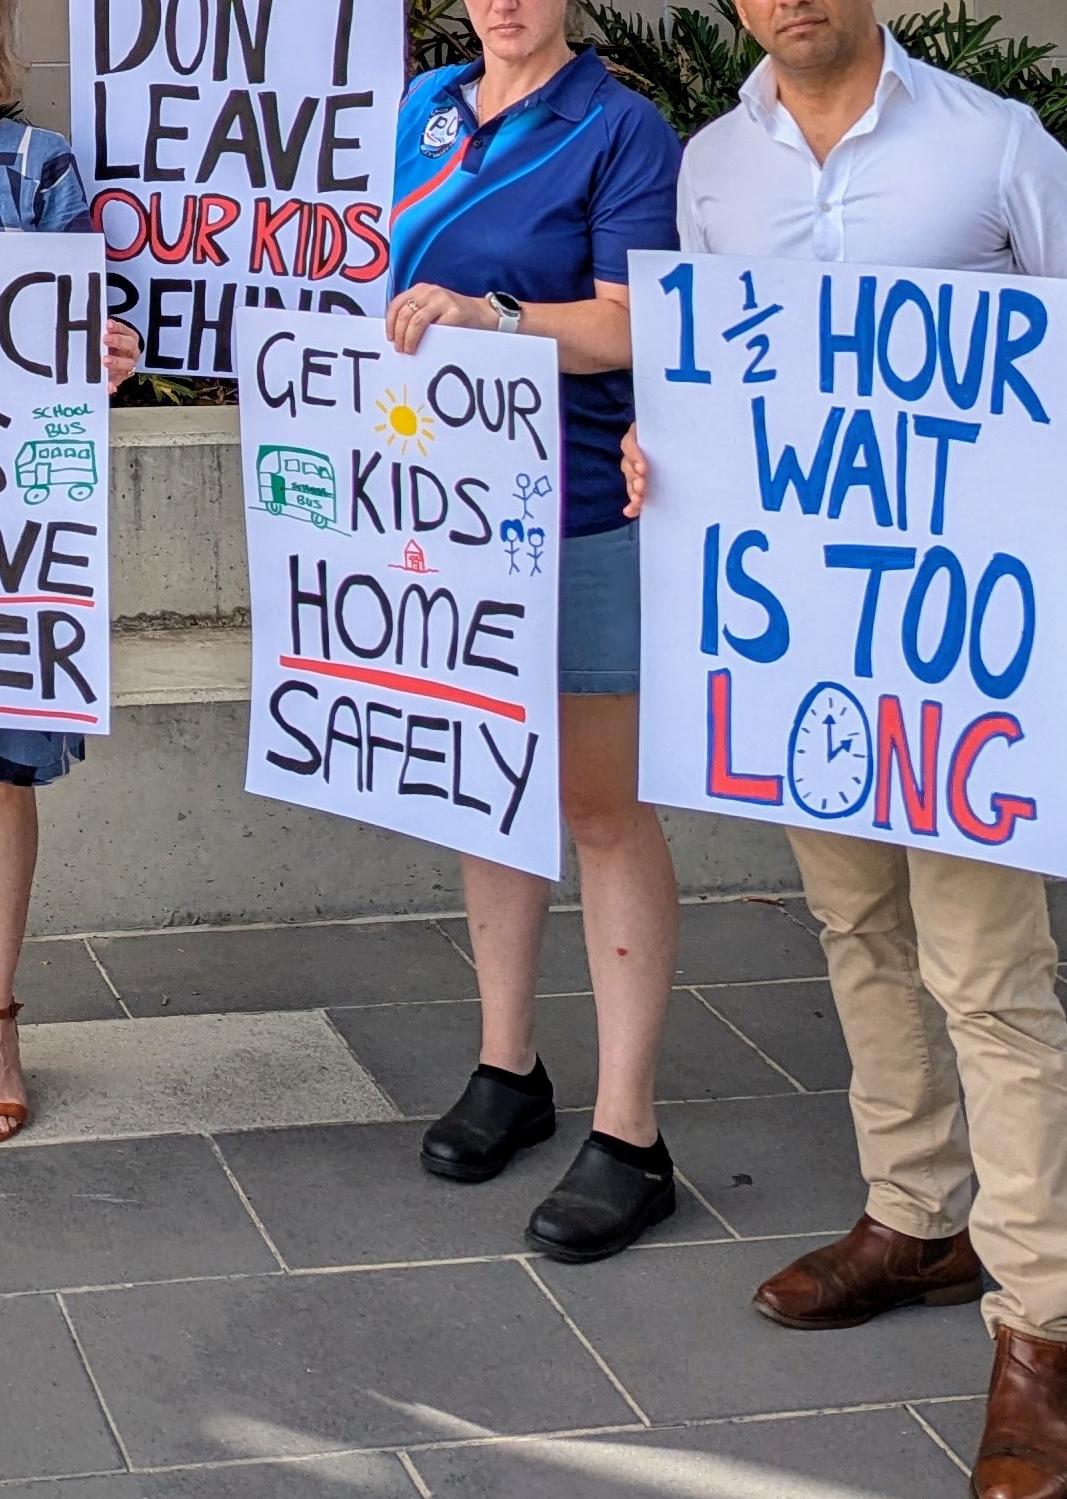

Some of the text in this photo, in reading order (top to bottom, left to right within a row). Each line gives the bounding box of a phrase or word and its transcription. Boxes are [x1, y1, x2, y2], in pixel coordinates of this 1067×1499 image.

[94, 81, 374, 192] LEAVE
[89, 188, 391, 282] OUR KIDS
[107, 272, 367, 372] BEH
[819, 275, 1051, 424] HOUR
[32, 403, 95, 419] SCHOOL
[44, 421, 87, 438] BUS
[256, 331, 548, 460] GET OUR
[350, 448, 493, 546] KIDS
[751, 392, 981, 535] WAIT
[288, 554, 525, 676] HOME
[700, 523, 1036, 700] IS TOO
[265, 680, 539, 836] SAFELY
